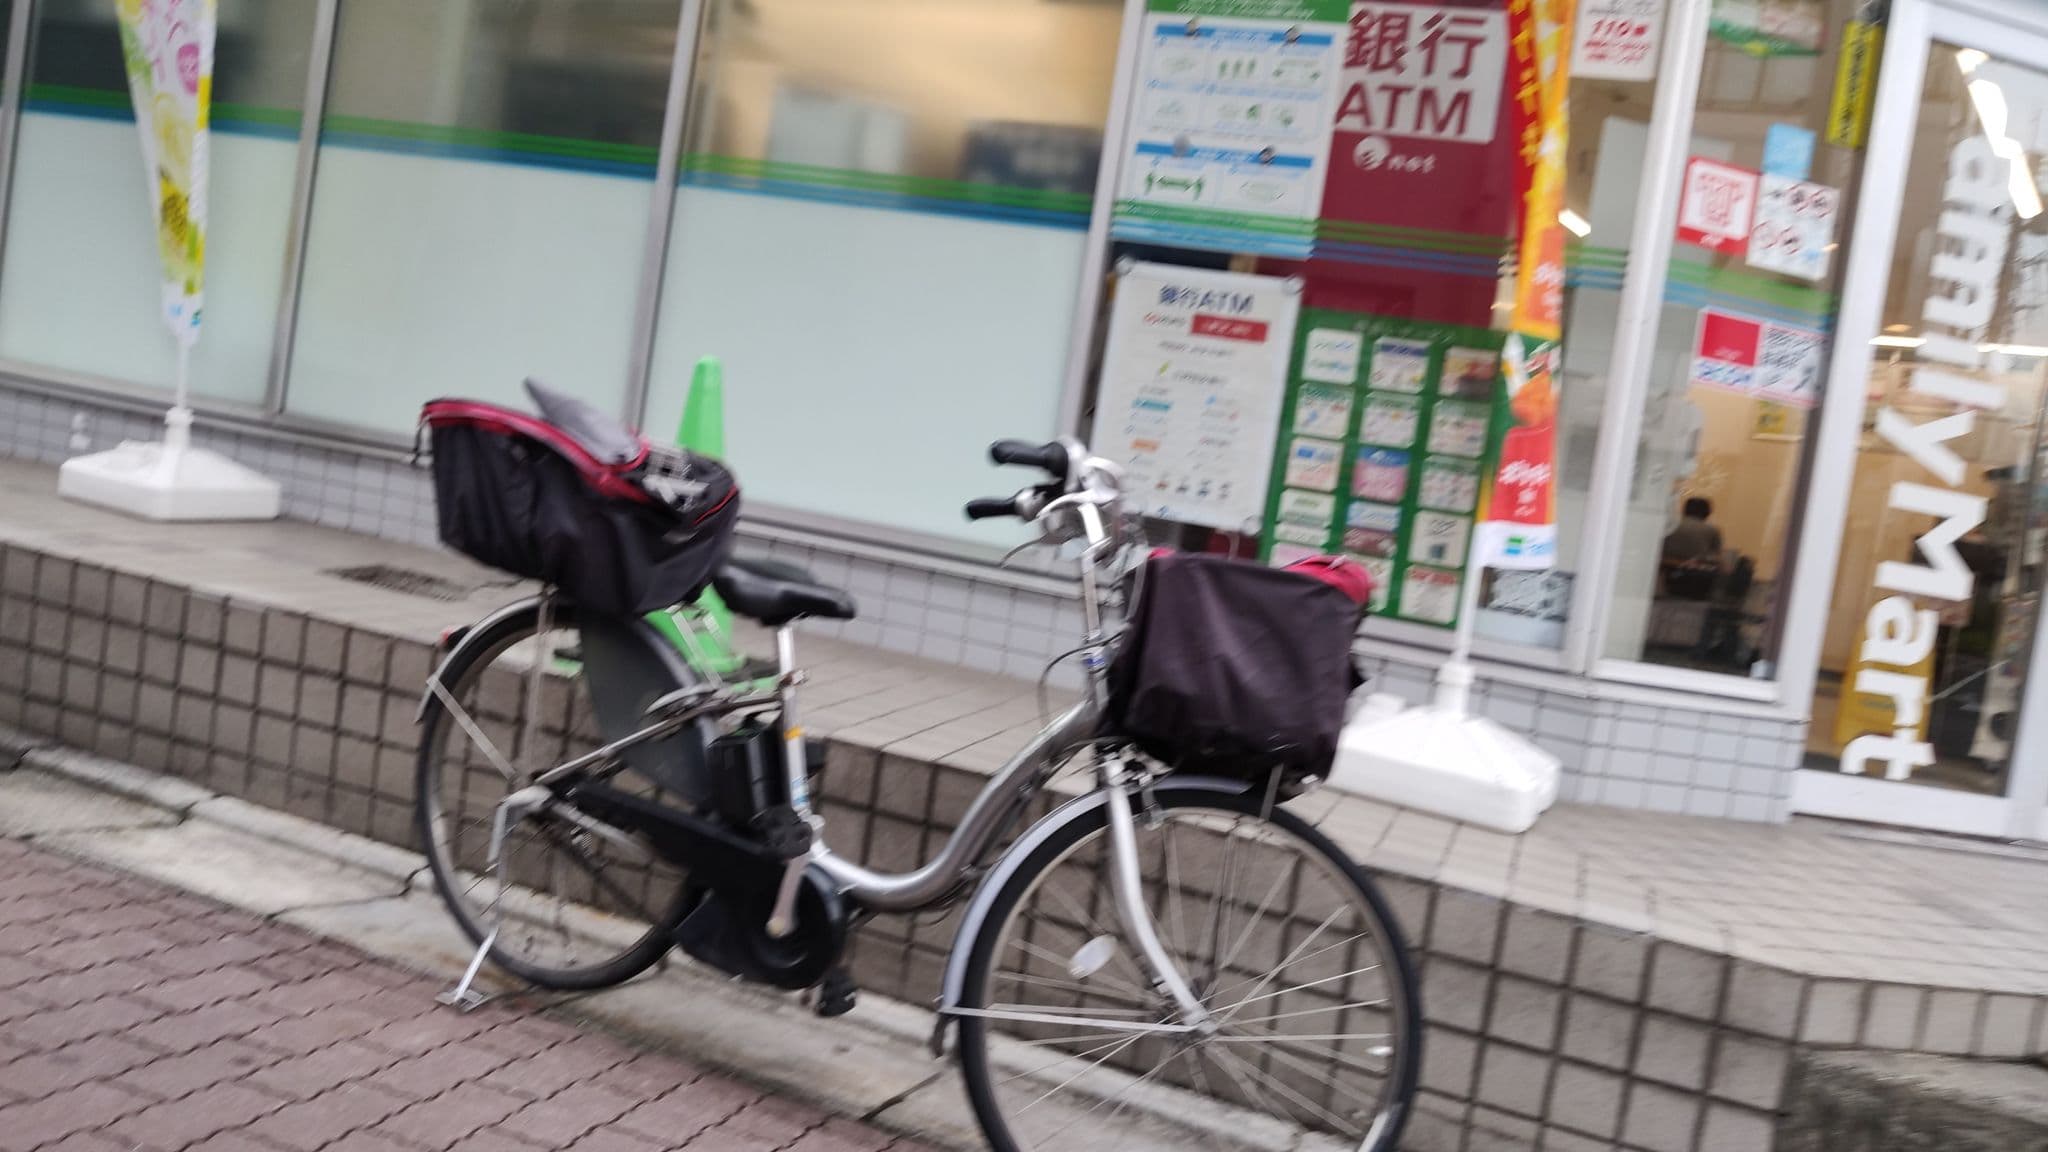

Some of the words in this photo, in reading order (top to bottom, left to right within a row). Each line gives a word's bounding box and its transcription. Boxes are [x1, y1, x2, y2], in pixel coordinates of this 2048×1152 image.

[1343, 9, 1487, 78] 銀行
[1334, 82, 1471, 135] ATM
[1841, 128, 2014, 780] amilyMart
